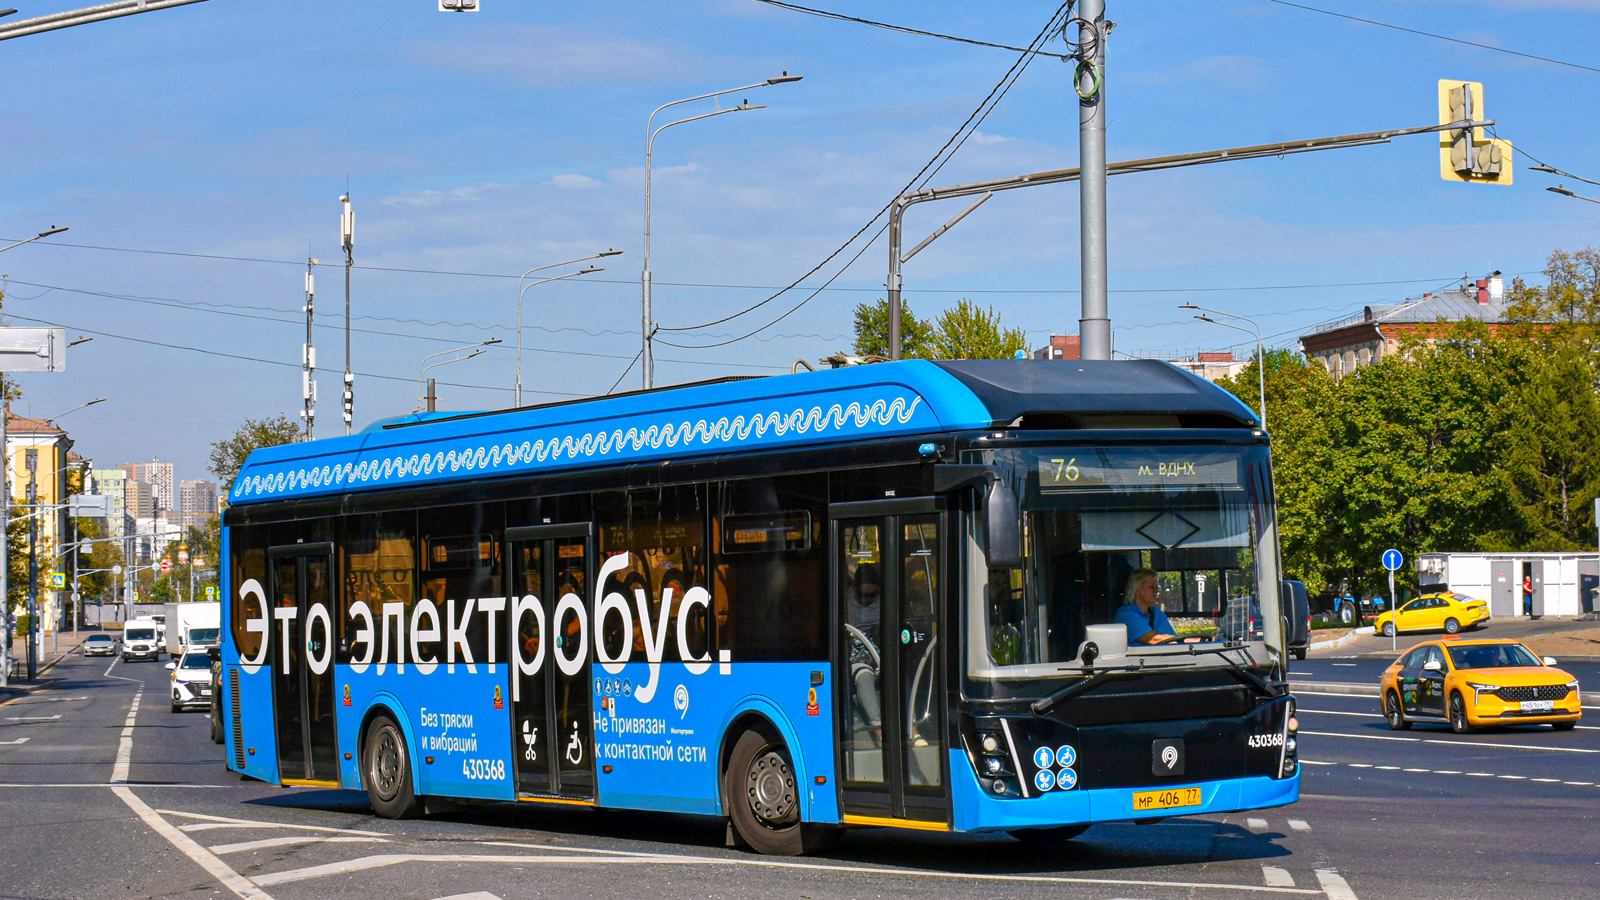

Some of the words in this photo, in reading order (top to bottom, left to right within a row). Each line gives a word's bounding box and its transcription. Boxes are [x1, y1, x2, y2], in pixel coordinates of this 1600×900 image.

[1051, 457, 1080, 482] 76
[1159, 462, 1196, 477] ВДНХ
[238, 578, 332, 675] Это
[348, 550, 732, 703] электробус.
[420, 707, 438, 727] Без
[440, 713, 473, 732] тряски
[593, 711, 608, 733] Не
[611, 717, 666, 738] привязан
[421, 735, 428, 750] и
[430, 732, 478, 756] вибраций
[595, 742, 601, 758] к
[604, 739, 674, 761] контактной
[677, 745, 707, 762] сети
[1248, 733, 1283, 748] 430368
[462, 759, 506, 780] 430368
[1139, 796, 1153, 808] МР
[1158, 791, 1180, 806] 406
[1186, 789, 1197, 800] 77
